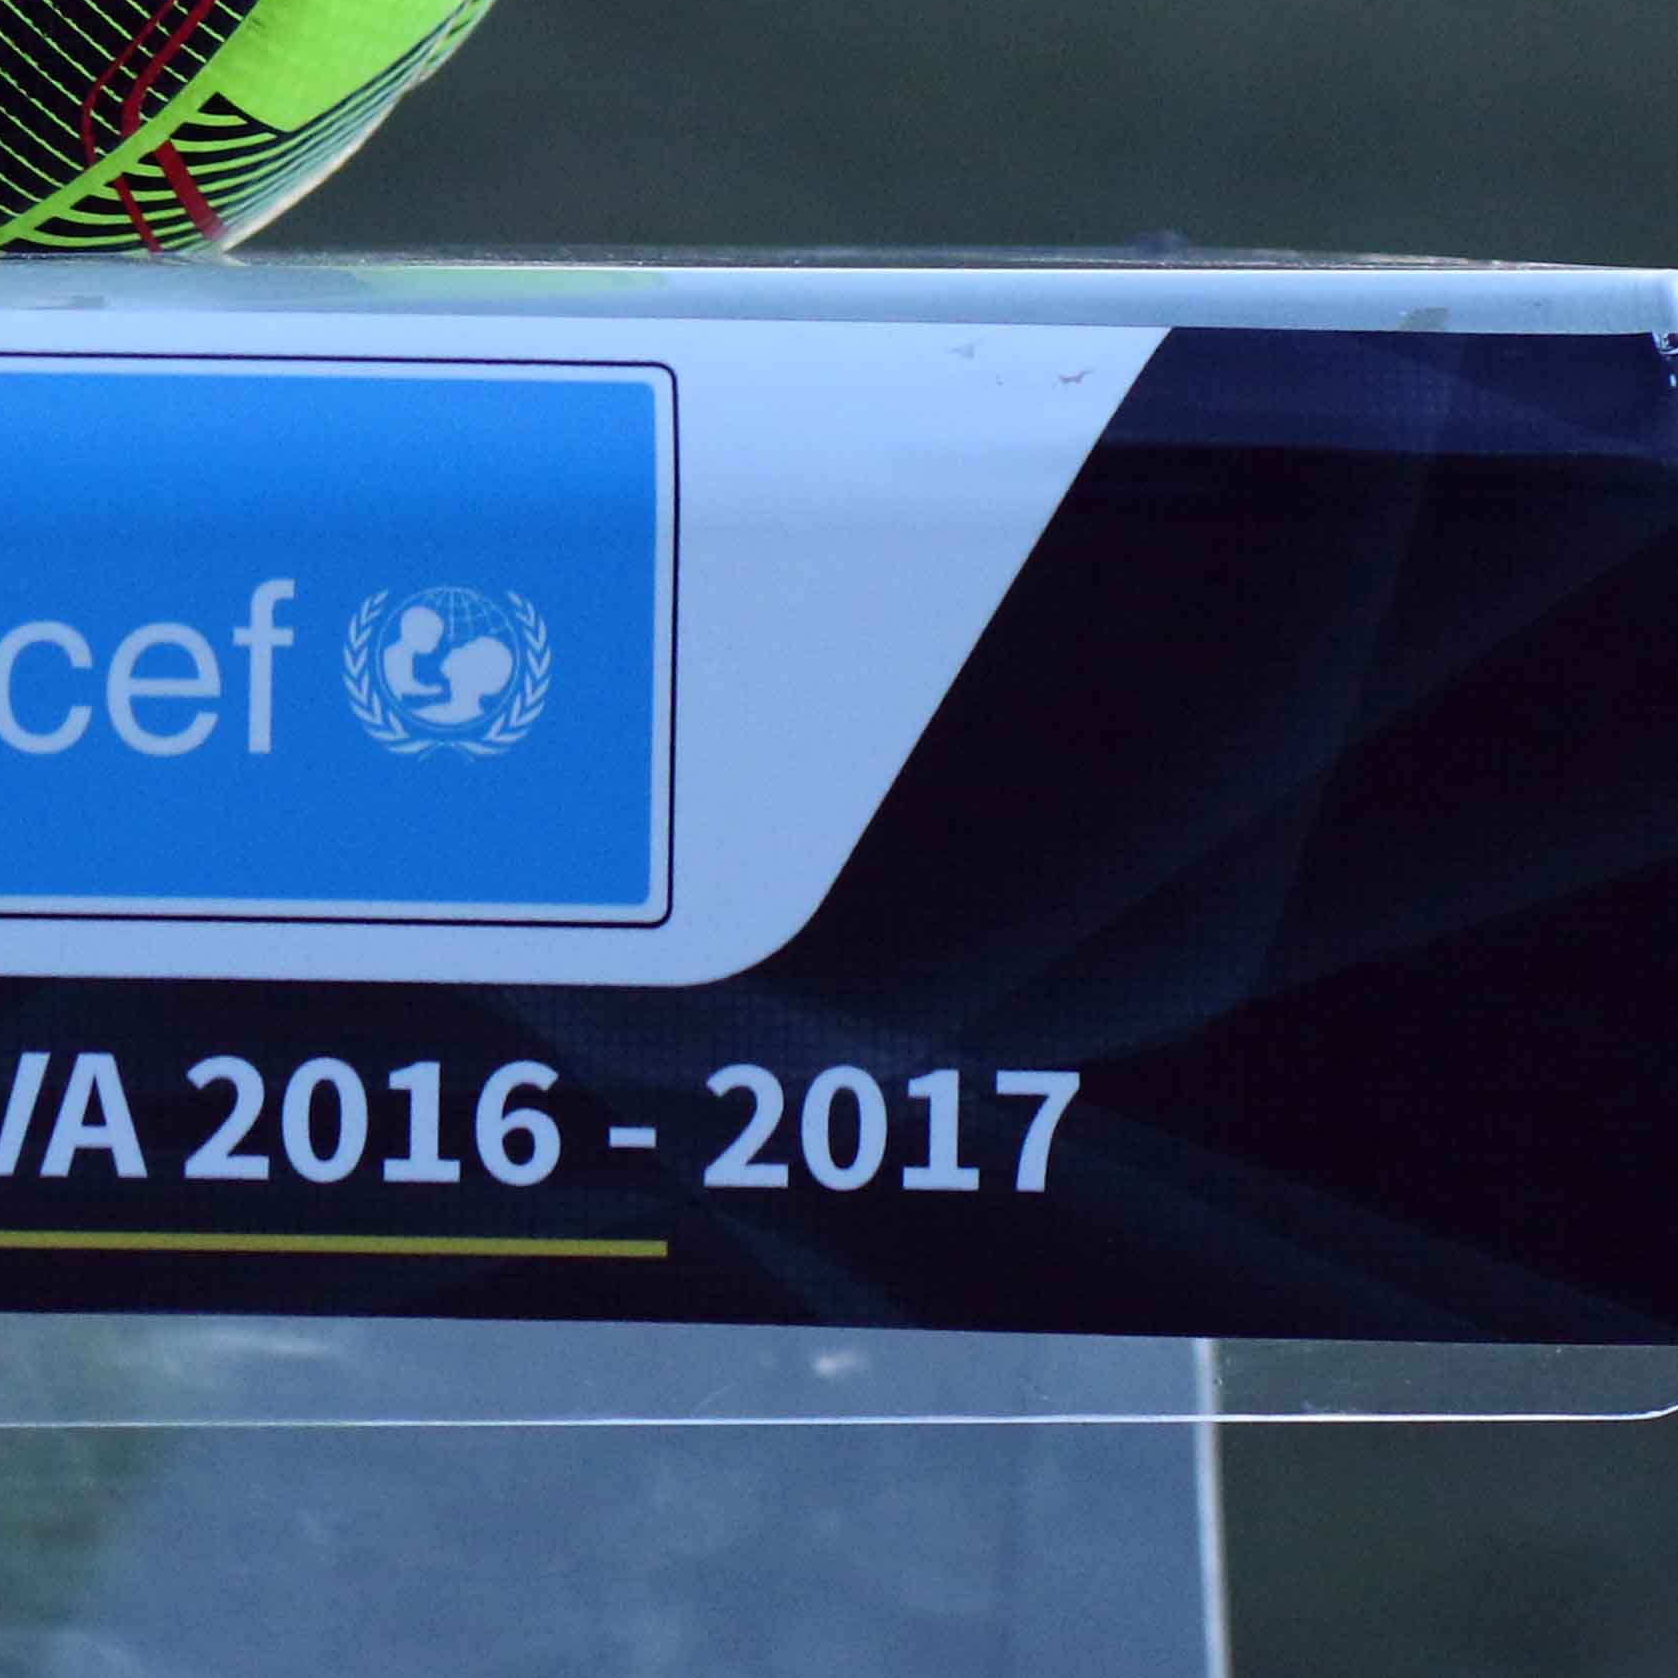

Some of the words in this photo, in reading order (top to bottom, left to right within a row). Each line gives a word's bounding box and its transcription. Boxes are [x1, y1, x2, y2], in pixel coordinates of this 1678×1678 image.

[185, 1056, 561, 1186] 2016
[609, 1126, 658, 1150] -
[704, 1065, 1082, 1192] 2017
